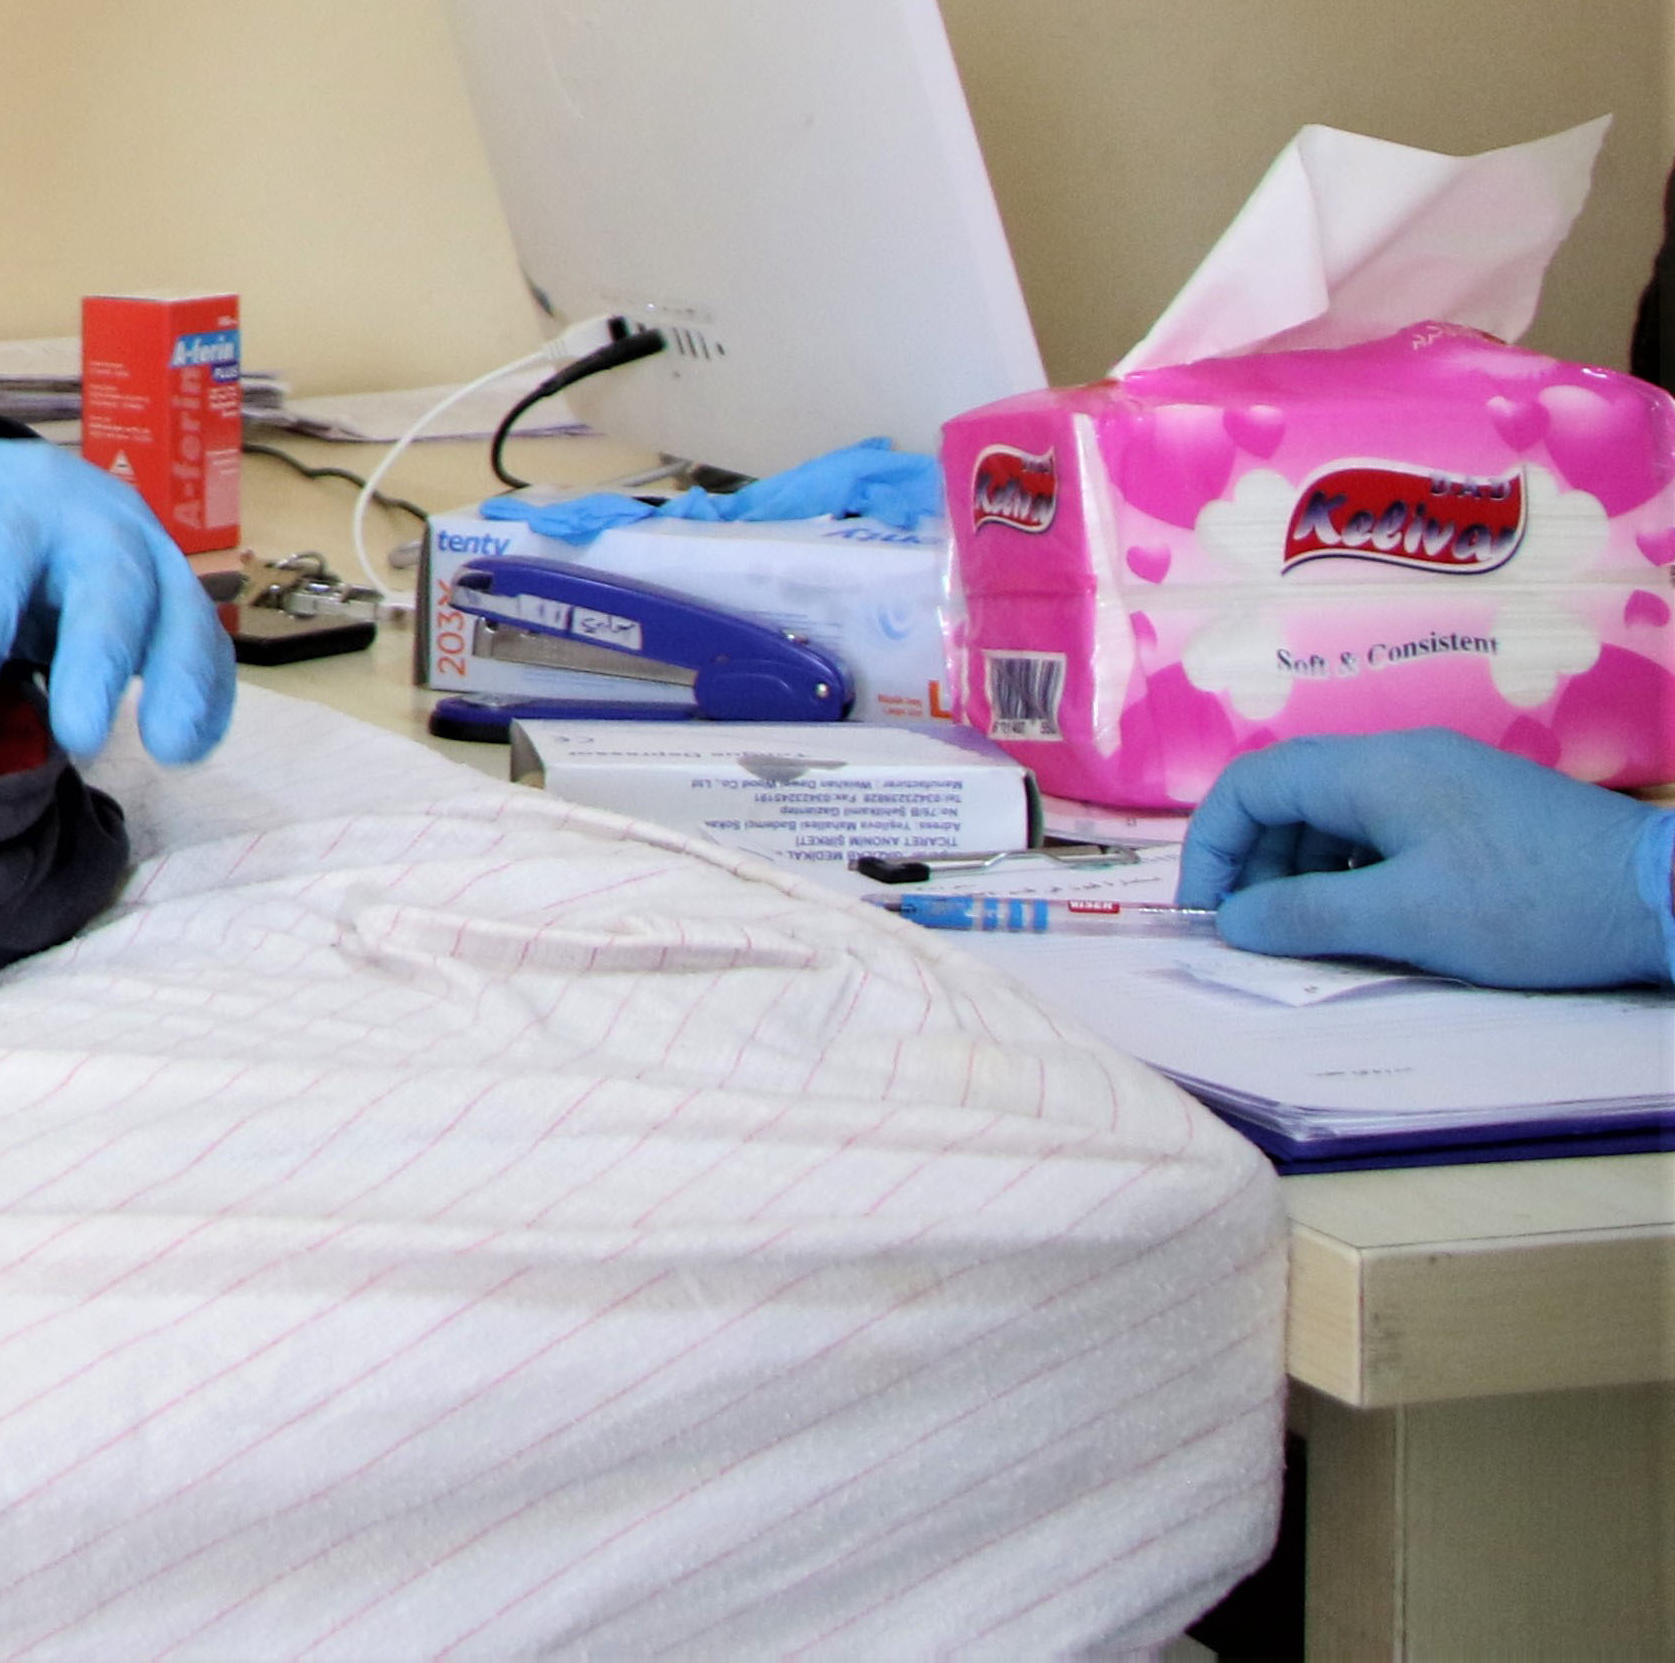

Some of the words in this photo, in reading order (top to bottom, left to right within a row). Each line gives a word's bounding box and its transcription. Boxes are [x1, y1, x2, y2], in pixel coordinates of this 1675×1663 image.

[1276, 648, 1326, 676] Soft
[1367, 631, 1500, 668] Consistent
[780, 805, 840, 816] Gaziantep
